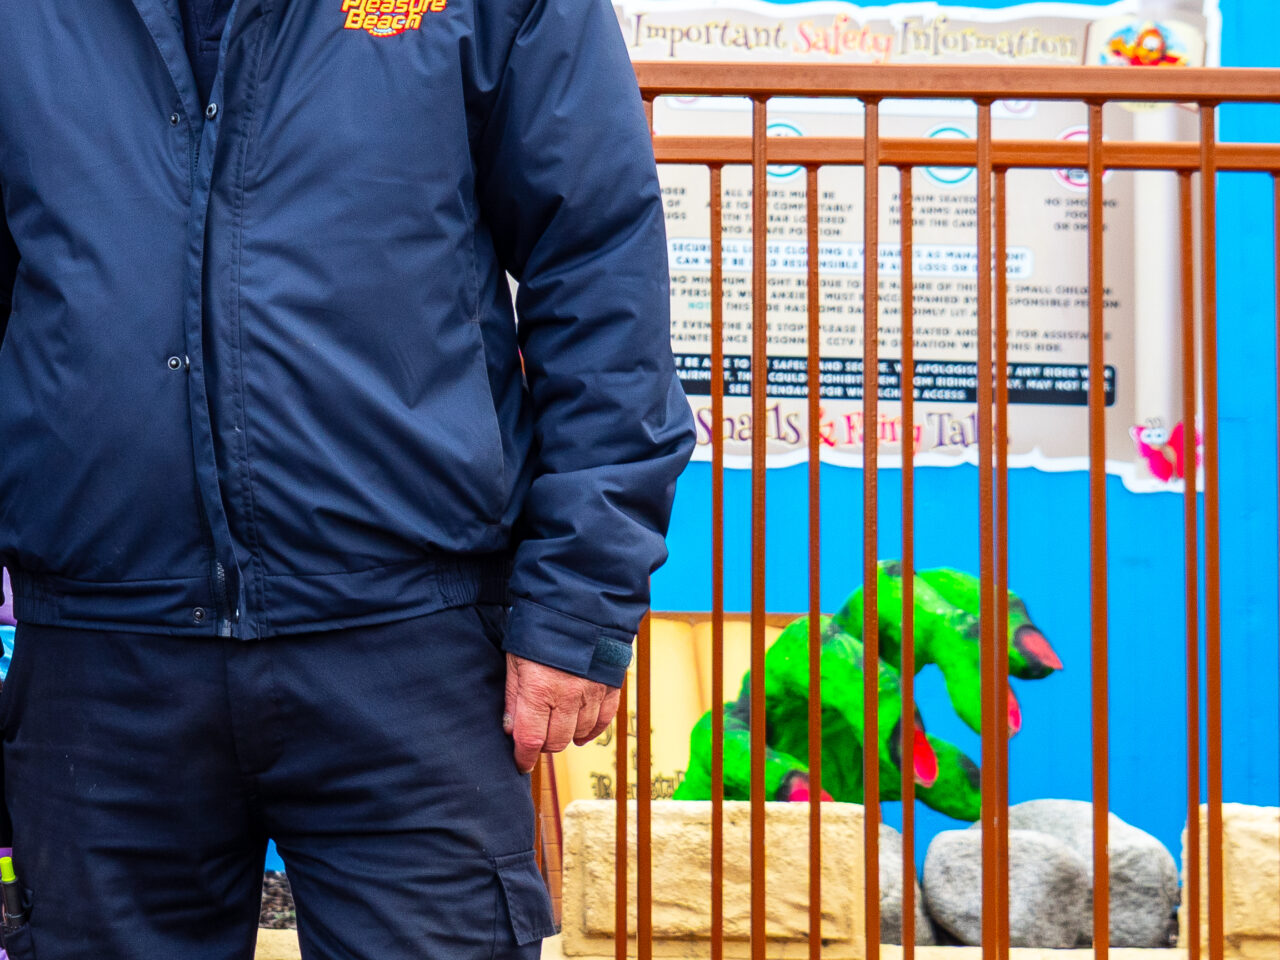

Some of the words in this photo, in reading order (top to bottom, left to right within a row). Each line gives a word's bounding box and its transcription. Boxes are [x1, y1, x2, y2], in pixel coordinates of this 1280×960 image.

[344, 8, 423, 30] Beach
[632, 12, 787, 57] Important
[793, 13, 893, 63] Safety
[897, 16, 1078, 58] Information
[725, 189, 744, 197] ALL
[747, 190, 786, 198] RERS
[773, 202, 853, 212] COMFTABLY
[782, 259, 858, 269] RESPNSIBLE
[687, 301, 710, 310] NOT
[772, 359, 808, 371] SAFEL
[728, 383, 750, 394] SEE
[697, 401, 801, 446] Snals
[926, 409, 1010, 449] Tal
